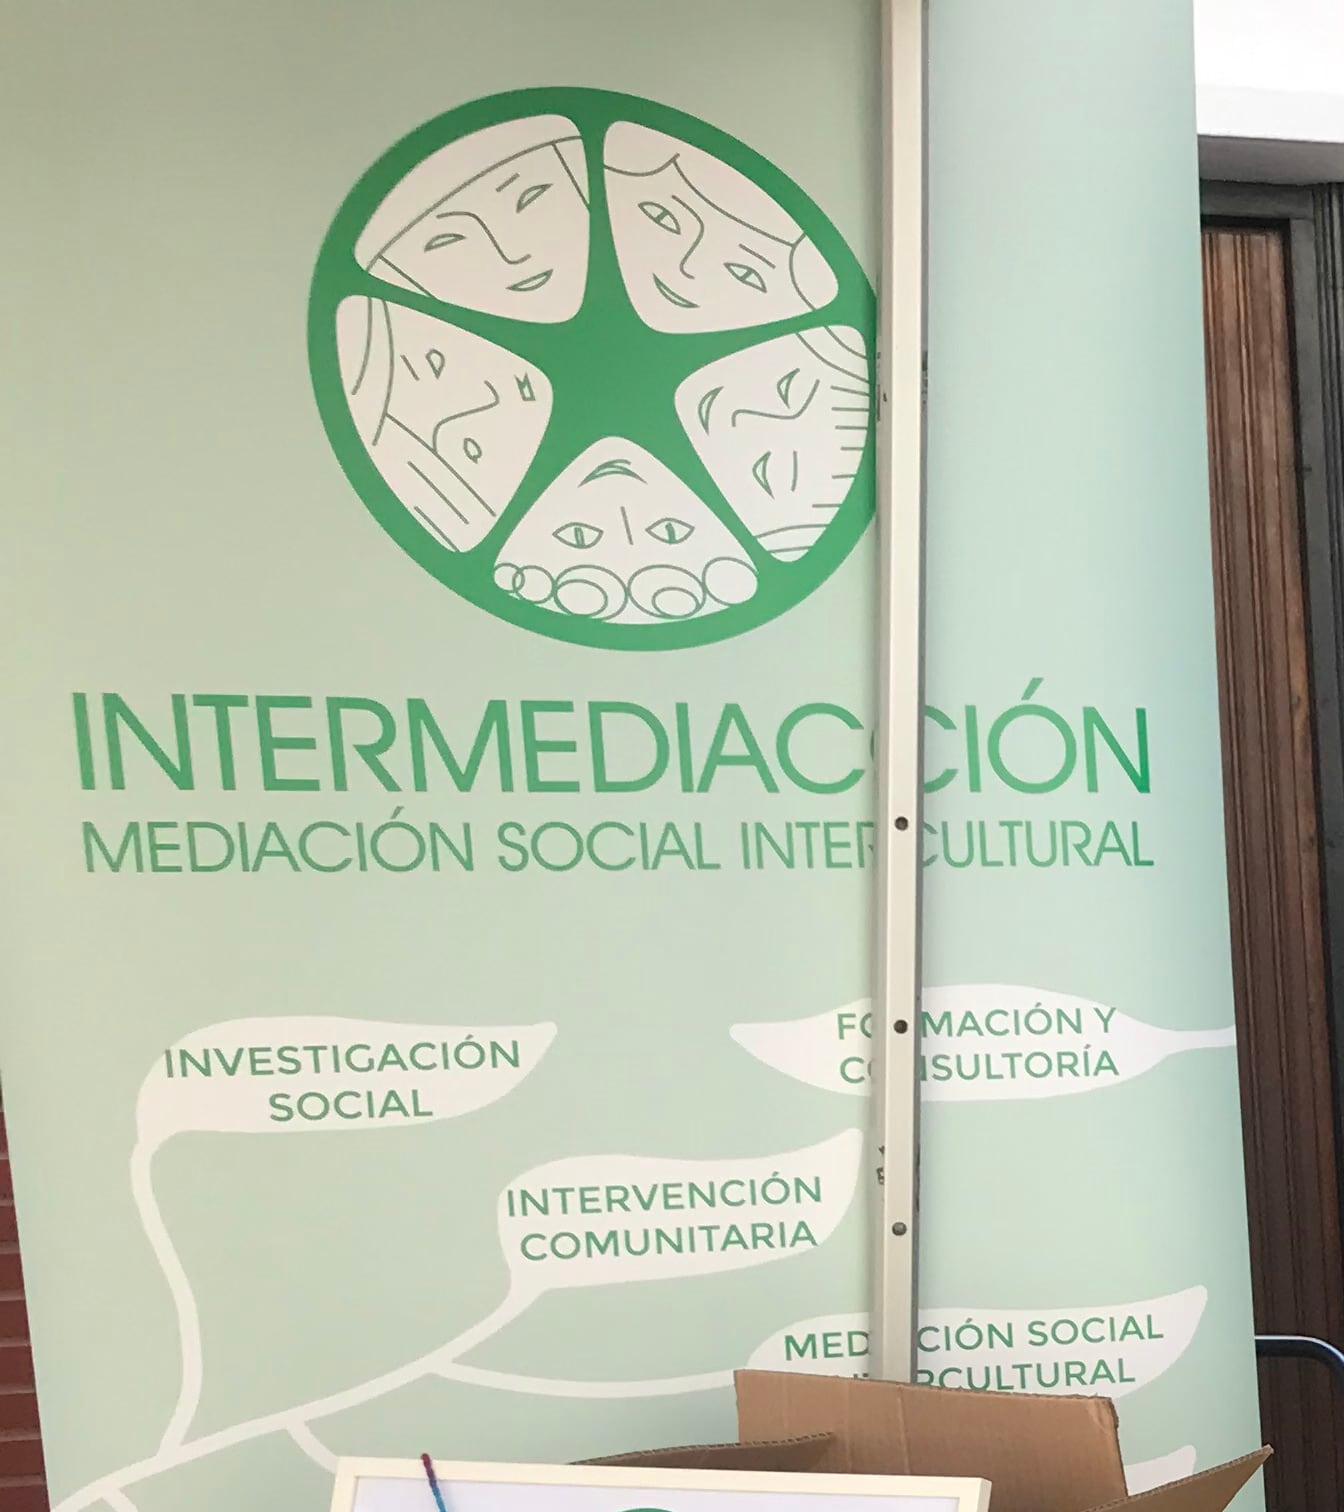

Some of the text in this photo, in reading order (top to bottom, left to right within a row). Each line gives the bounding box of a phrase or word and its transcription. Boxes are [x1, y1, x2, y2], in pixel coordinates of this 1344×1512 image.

[82, 806, 474, 873] MEDIACIÓN
[498, 820, 721, 873] SOCIAL
[1094, 1007, 1117, 1034] Y
[165, 1034, 521, 1078] INVESTIGACIÓN
[840, 1044, 1120, 1085] CSULTORÍA
[269, 1088, 434, 1123] SOCIAL
[507, 1170, 822, 1218] INTERVENCIÓN
[519, 1220, 819, 1262] COMUNITARIA
[784, 1313, 1164, 1361] MEDCIÓN SOCIAL
